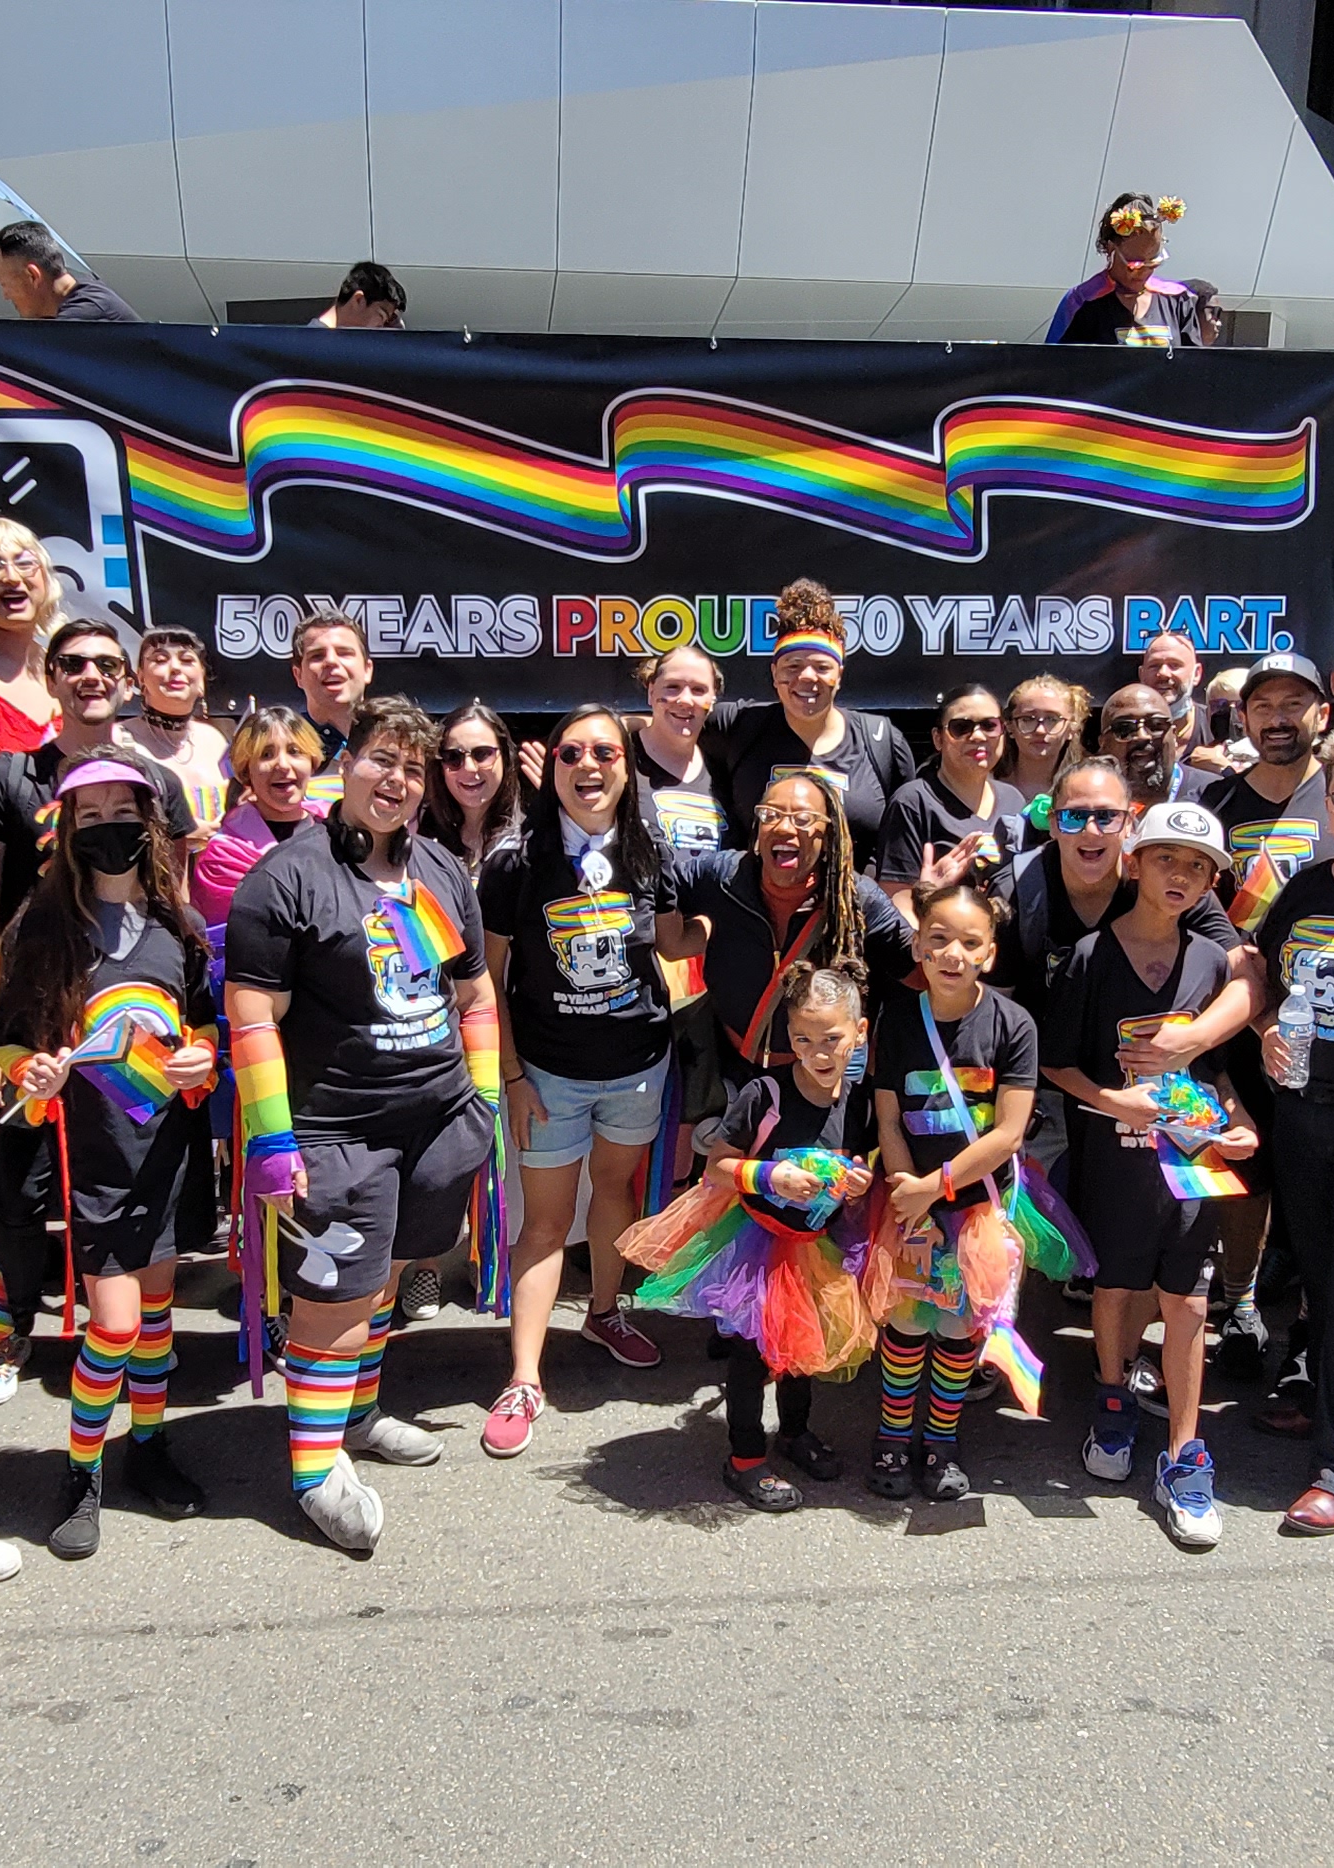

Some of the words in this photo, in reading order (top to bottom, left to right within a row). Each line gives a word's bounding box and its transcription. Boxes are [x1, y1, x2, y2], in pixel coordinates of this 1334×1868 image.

[214, 594, 302, 659] 50
[903, 594, 1115, 656] YEARS
[1122, 594, 1295, 656] BART.
